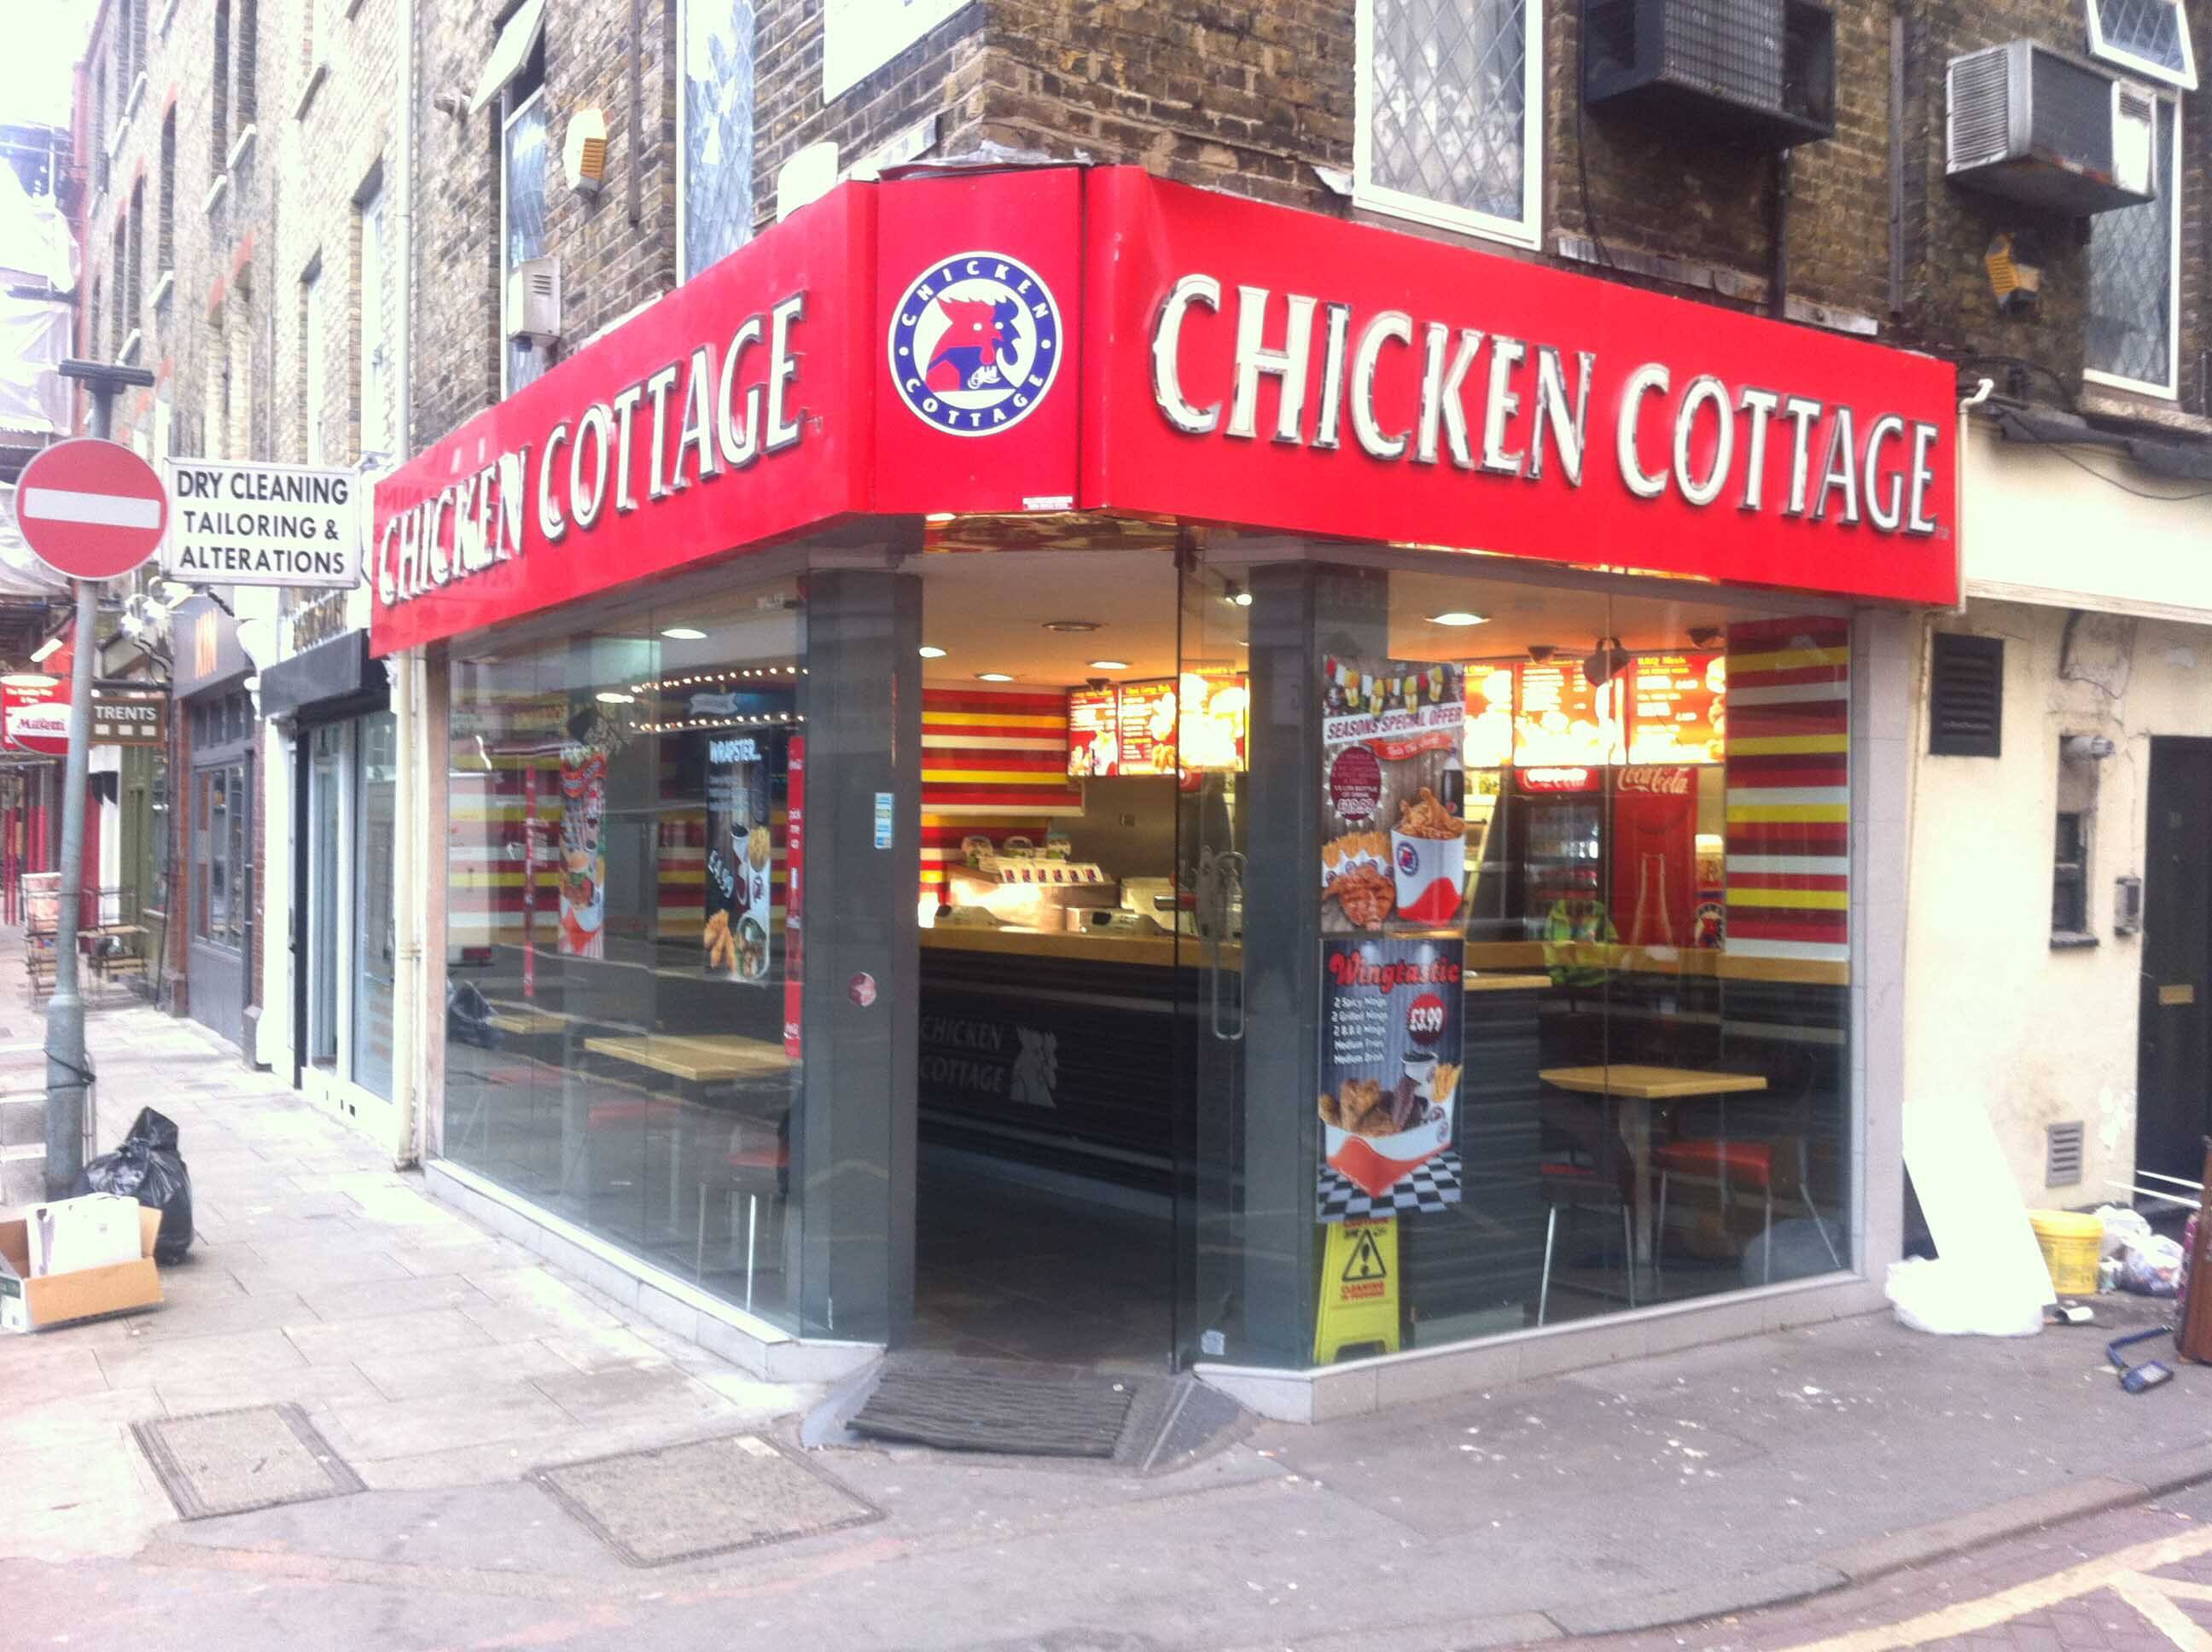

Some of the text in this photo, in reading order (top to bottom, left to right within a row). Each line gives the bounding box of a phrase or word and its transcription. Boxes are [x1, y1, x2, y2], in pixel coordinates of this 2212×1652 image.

[901, 260, 1049, 427] CHICKEN COTTAGE
[1152, 273, 1938, 536] CHICKEN COTTAGE
[379, 291, 807, 608] CHICKEN COTTAGE
[178, 470, 348, 505] DRY CLEANING
[183, 510, 339, 540] TAILORING &
[180, 545, 344, 575] ALTERATIONS
[94, 706, 157, 721] TRENTS
[1329, 949, 1461, 994] Wingtastic
